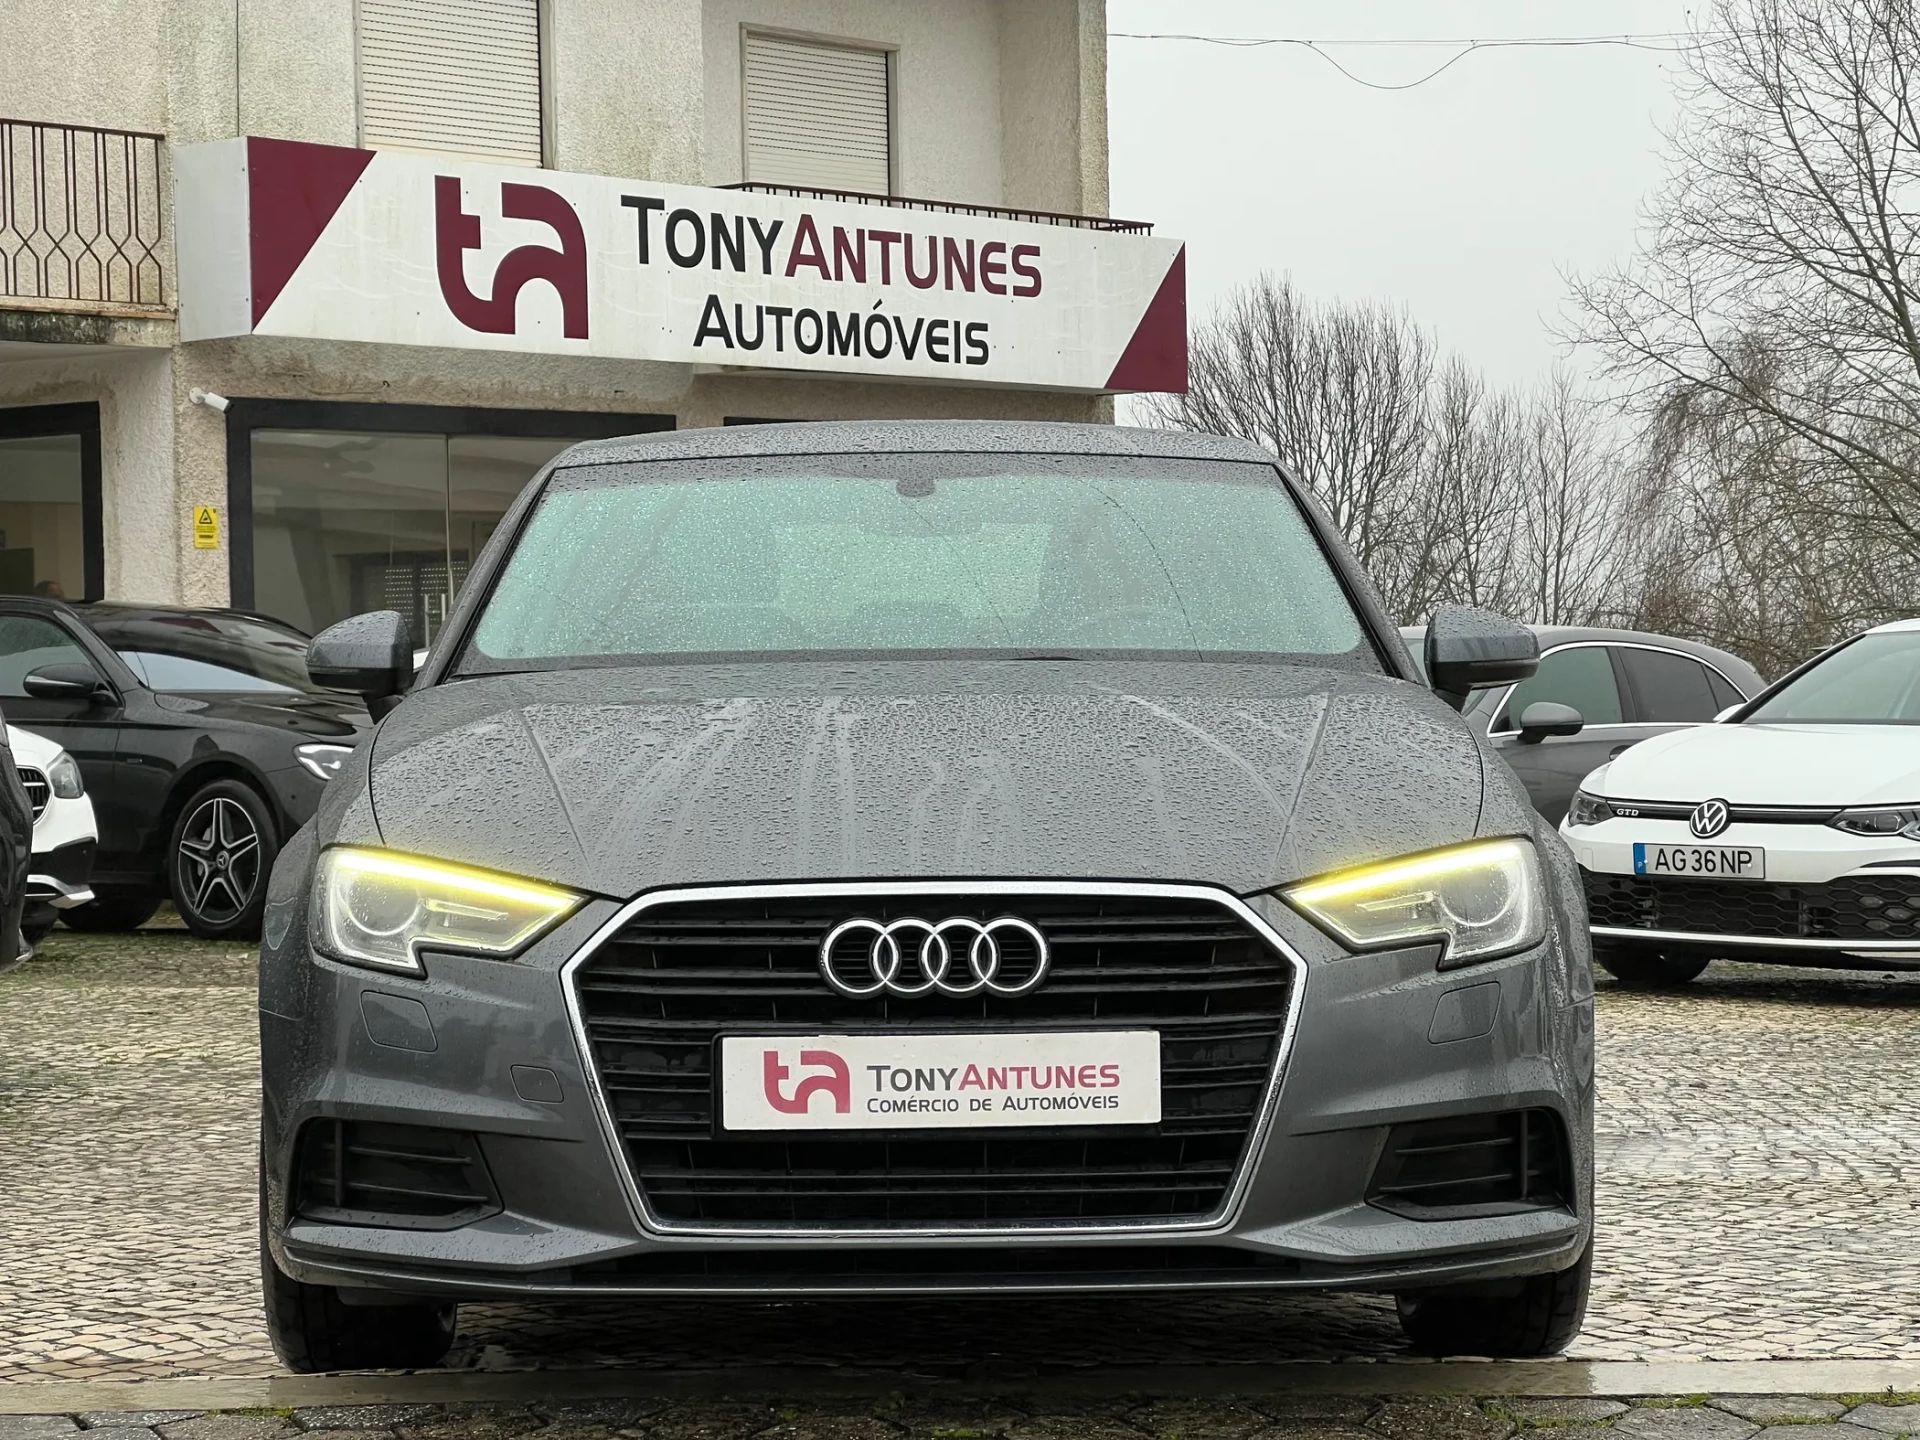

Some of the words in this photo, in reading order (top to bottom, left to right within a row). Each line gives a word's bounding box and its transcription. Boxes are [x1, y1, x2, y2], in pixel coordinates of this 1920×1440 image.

[693, 294, 989, 366] AUTOMÓVEIS
[1616, 808, 1639, 817] GTD
[867, 1095, 959, 1113] COMÉRCIO
[969, 1098, 992, 1112] DE
[1001, 1092, 1119, 1111] AUTOMÓVEIS
